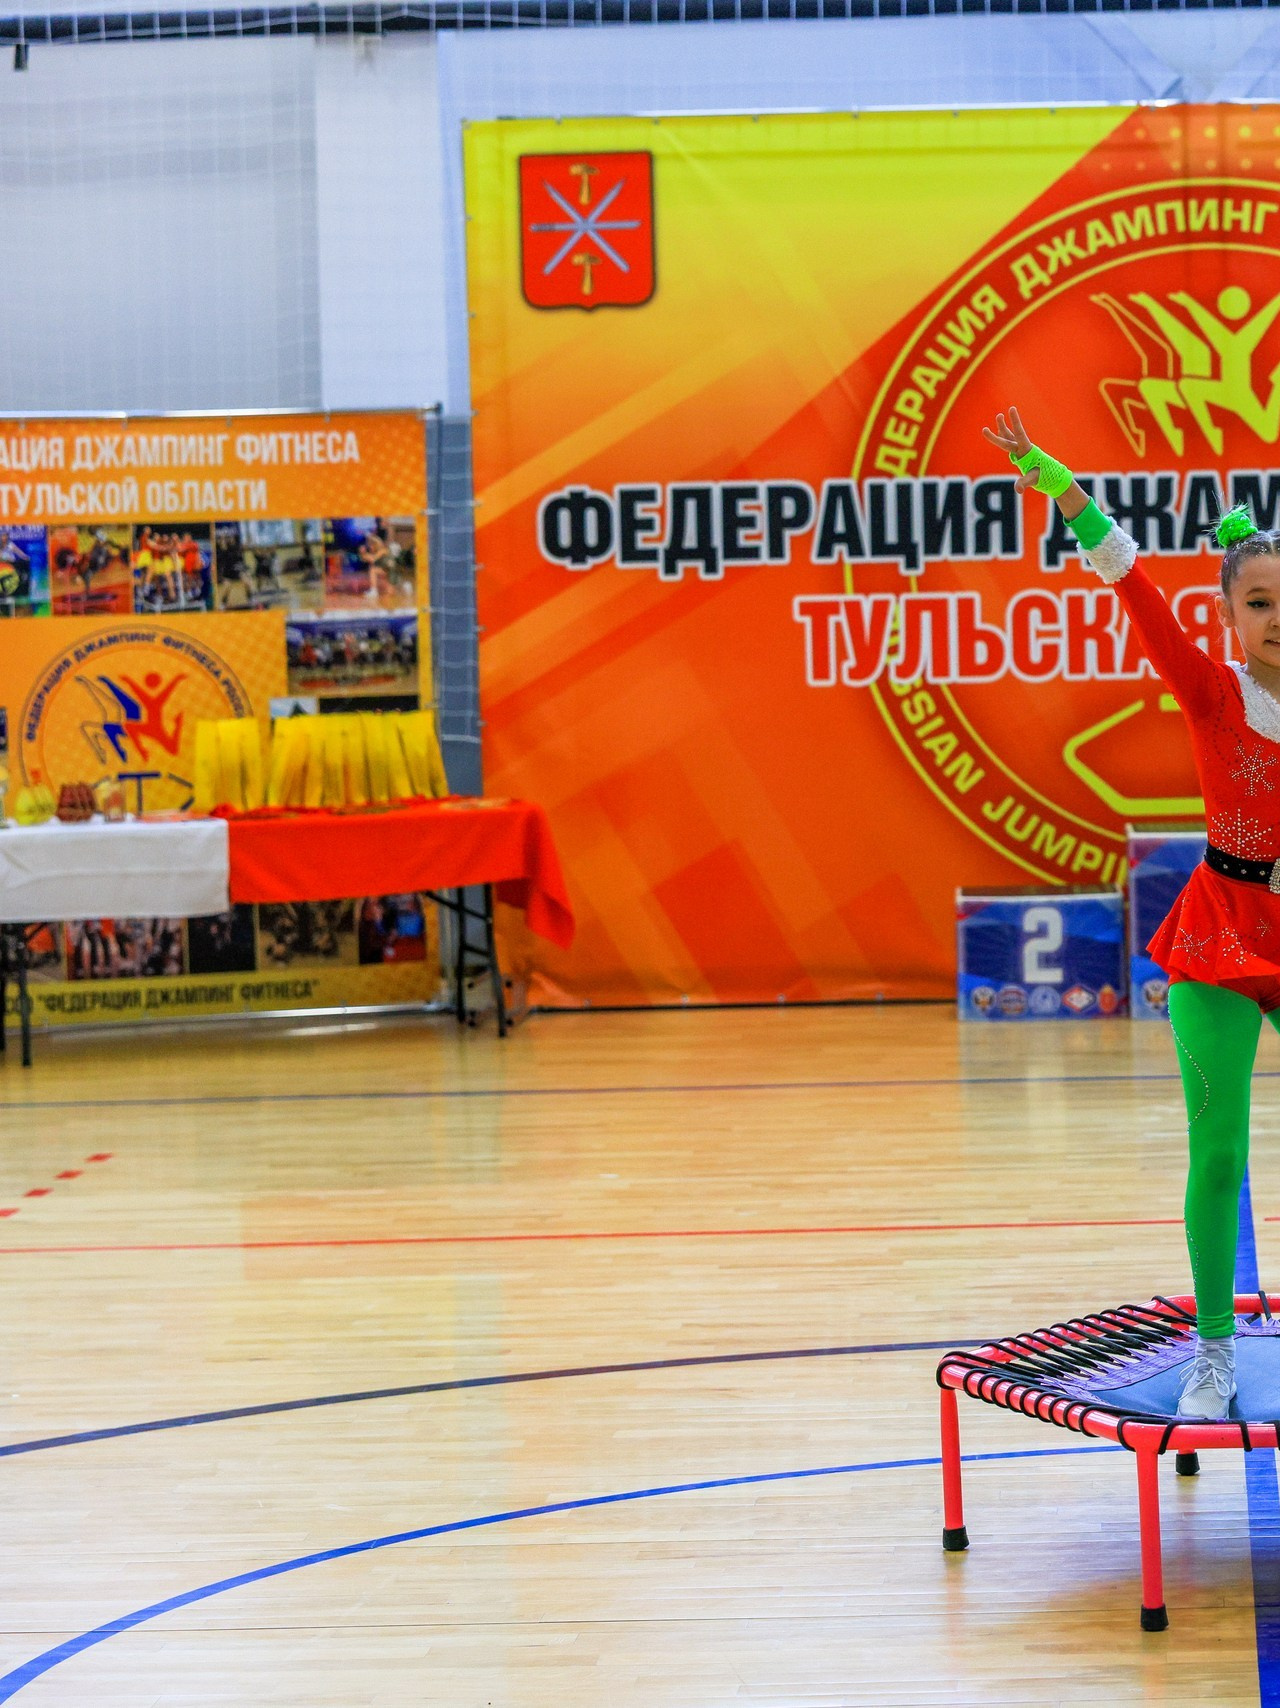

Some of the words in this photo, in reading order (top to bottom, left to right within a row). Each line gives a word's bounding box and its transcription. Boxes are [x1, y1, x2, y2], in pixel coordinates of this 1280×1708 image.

[874, 284, 1008, 477] ДЕРАЦИЯ
[1009, 198, 1279, 300] ДЖАМПИНГ
[71, 433, 231, 472] ДЖАМПИНГ
[235, 430, 360, 467] ФИТНЕСА
[0, 477, 140, 517] ТУЛЬСКОЙ
[145, 478, 268, 513] ОБЛАСТИ
[537, 475, 1019, 580] ФЕДЕРАЦИЯ
[886, 640, 985, 794] SIAN
[981, 795, 1127, 886] JUMPI
[1022, 906, 1064, 984] 2
